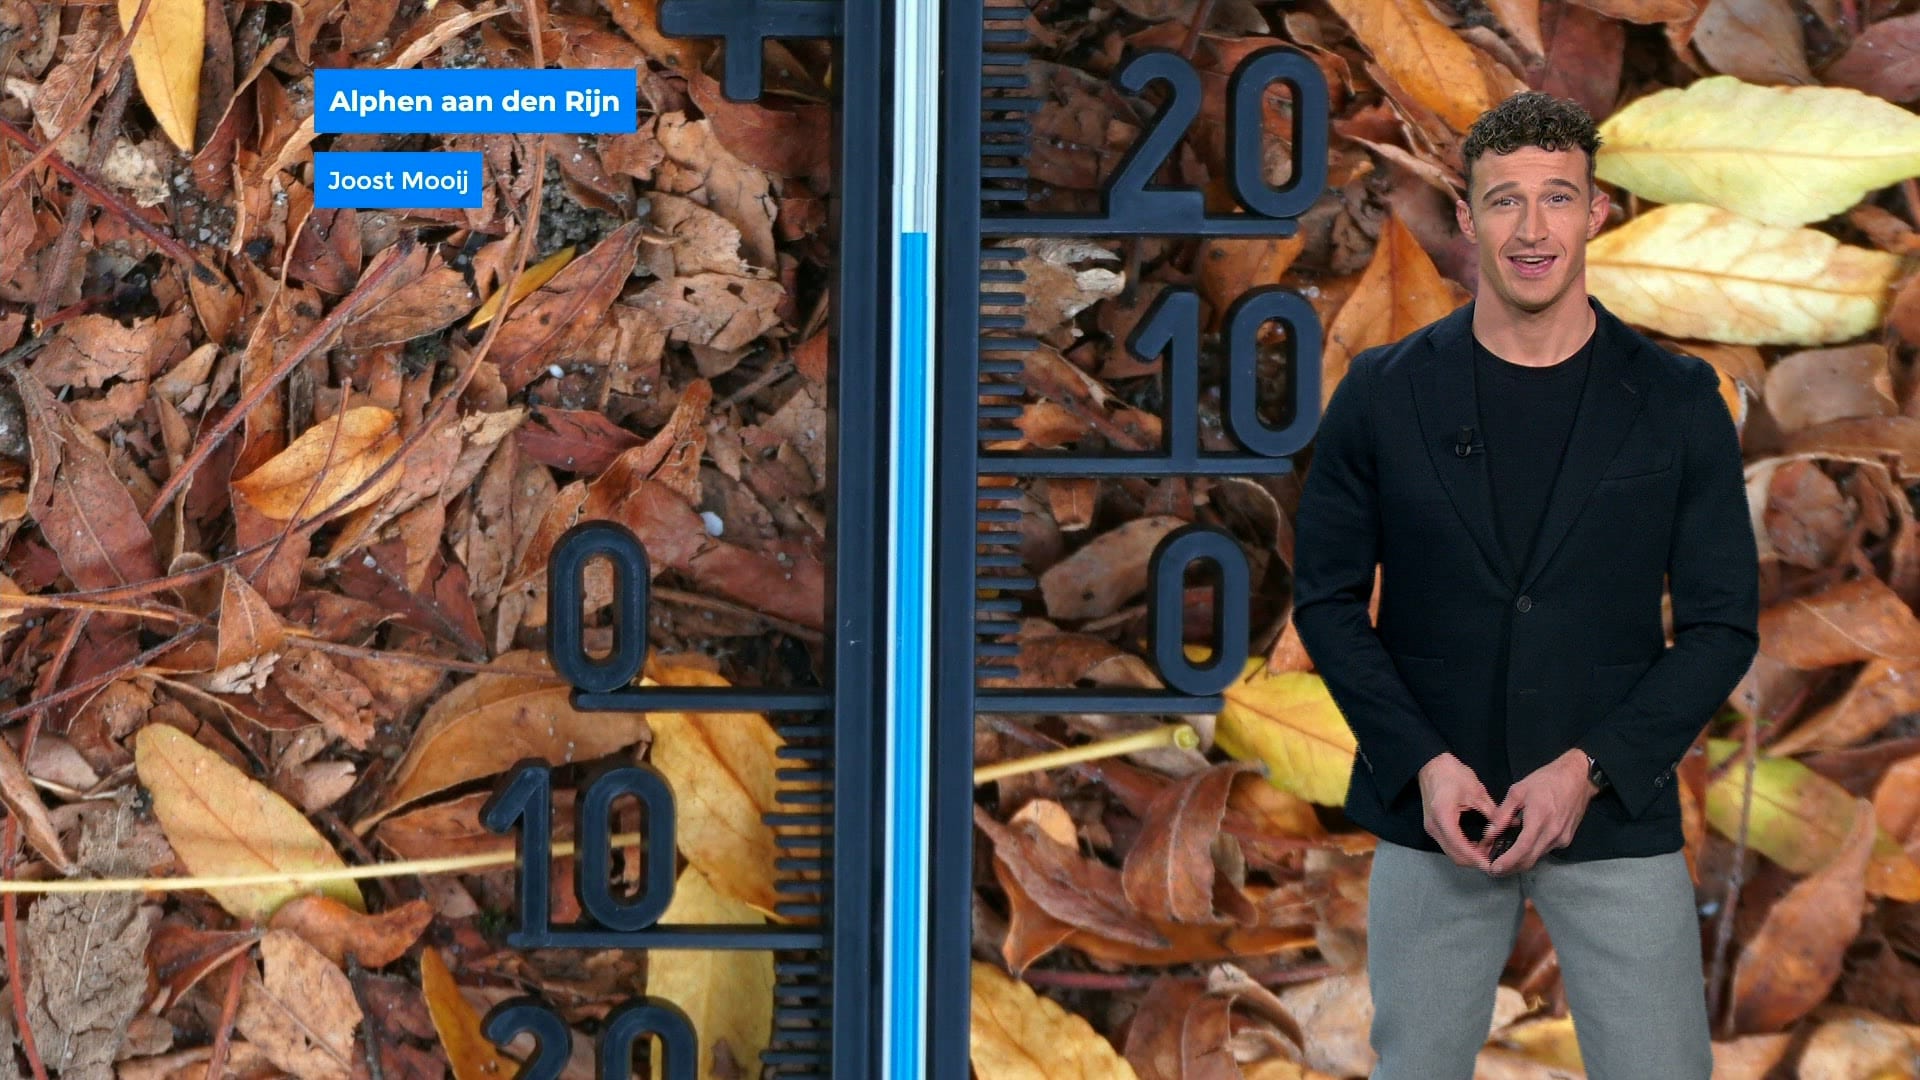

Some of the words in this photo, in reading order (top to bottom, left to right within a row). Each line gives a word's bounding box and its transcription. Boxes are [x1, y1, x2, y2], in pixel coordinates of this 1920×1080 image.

[1114, 48, 1330, 220] 20
[1130, 288, 1323, 460] 10
[548, 521, 649, 692] 0
[1150, 528, 1250, 696] 0
[481, 758, 675, 942] 10
